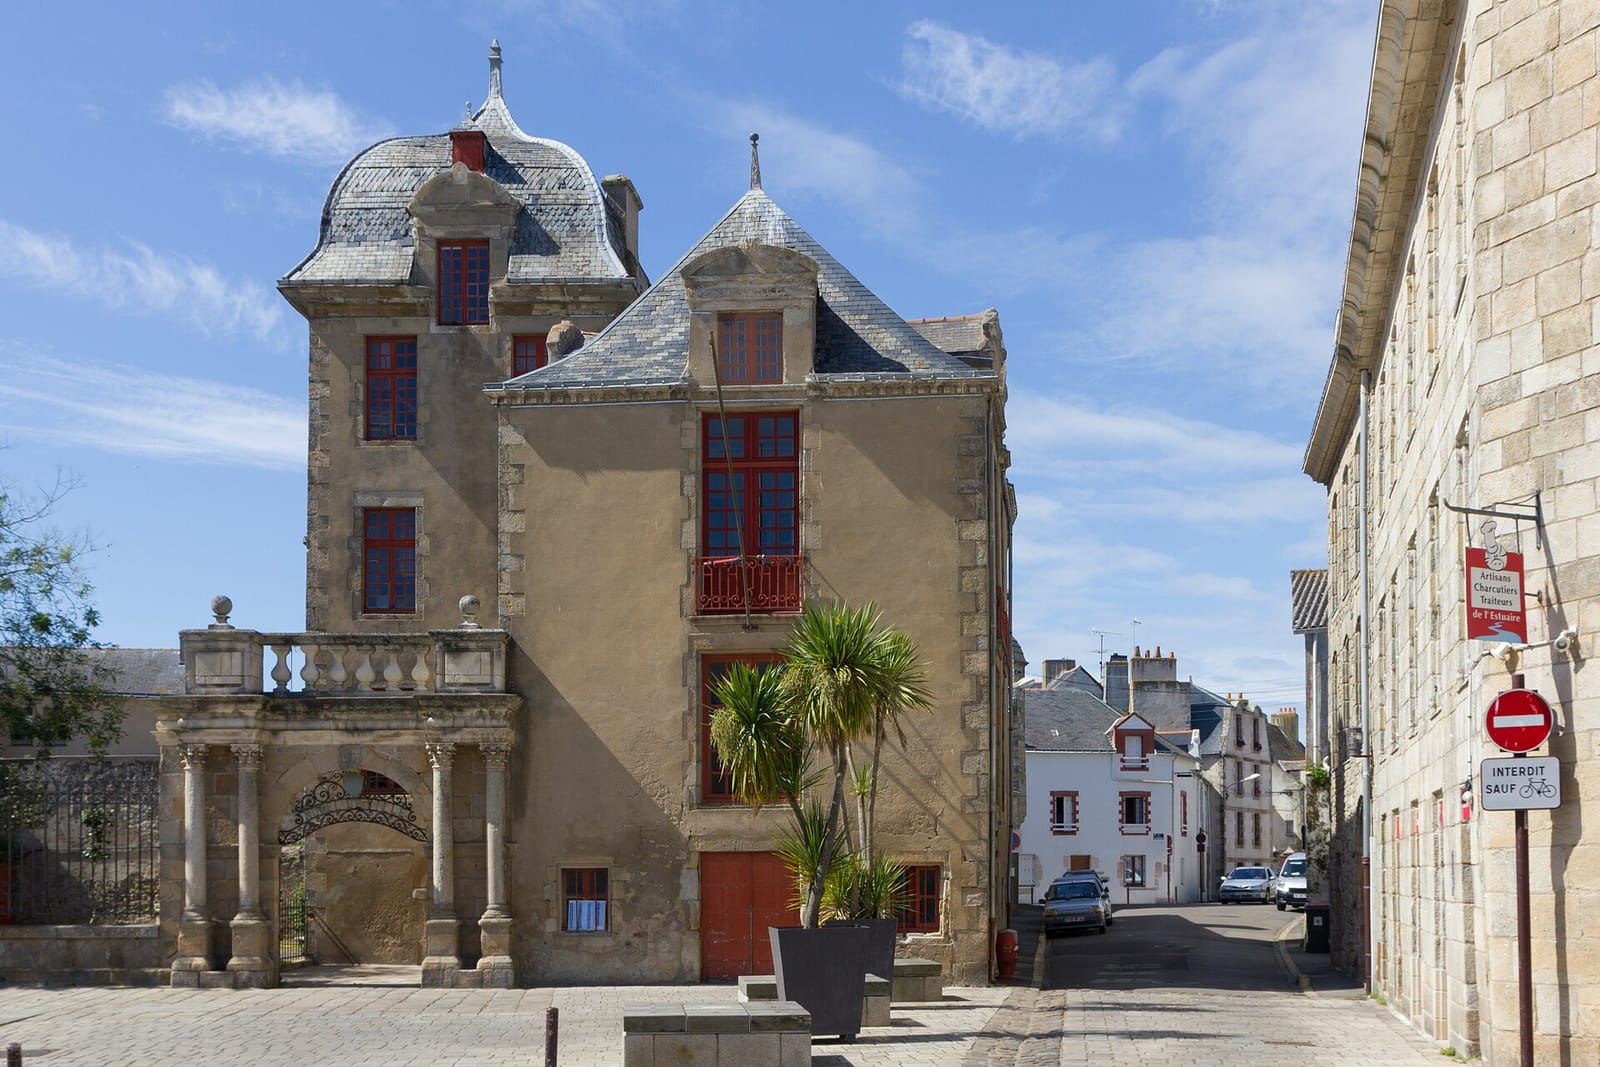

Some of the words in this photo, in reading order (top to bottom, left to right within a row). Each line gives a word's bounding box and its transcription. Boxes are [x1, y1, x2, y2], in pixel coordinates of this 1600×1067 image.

[1480, 571, 1511, 583] Artisans
[1474, 582, 1518, 595] Charcutiers
[1480, 595, 1513, 607] Traiteurs
[1472, 609, 1482, 619] de
[1492, 766, 1545, 777] INTERDIT
[1486, 783, 1516, 794] SAUF
